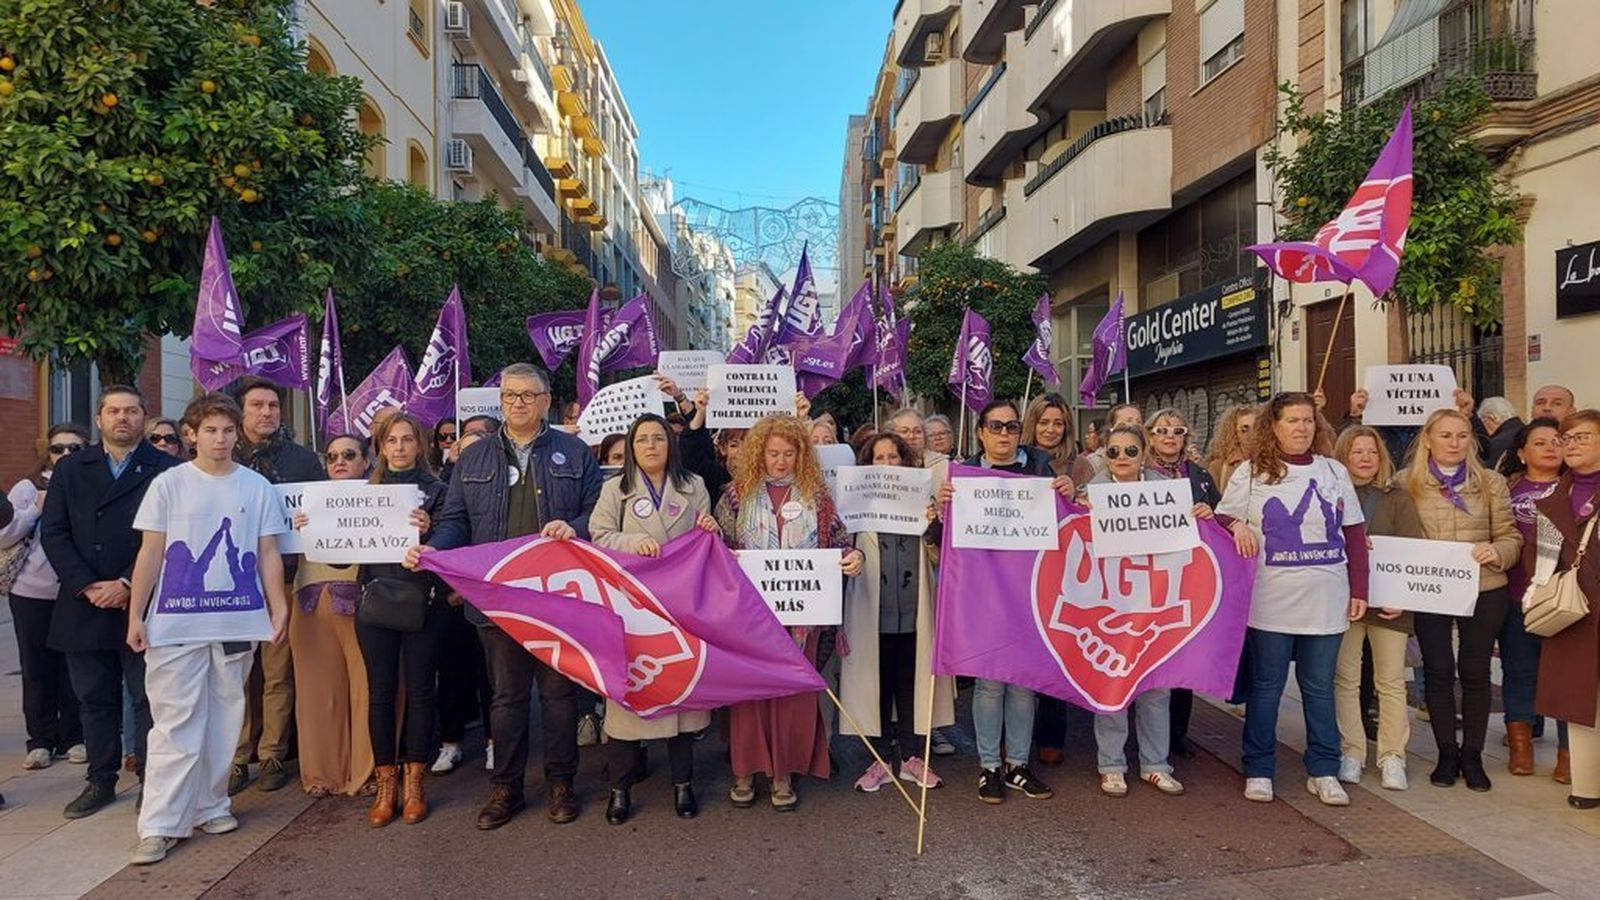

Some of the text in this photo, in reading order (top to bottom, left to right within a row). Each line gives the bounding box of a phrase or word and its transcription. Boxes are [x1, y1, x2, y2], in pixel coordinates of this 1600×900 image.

[1127, 311, 1160, 350] Gold
[1161, 300, 1218, 340] Center
[726, 373, 778, 381] CONTRA LA
[1389, 373, 1435, 383] NI UNA
[727, 385, 777, 393] VIOLENCIA
[1386, 387, 1440, 399] VÍCTIMA
[728, 398, 777, 406] MACHISTA
[712, 410, 764, 418] TOLERACIA
[1397, 403, 1424, 415] MÁS
[587, 412, 644, 426] VIOLENC
[883, 473, 901, 481] QUE
[973, 488, 1035, 500] ROMPE EL
[1107, 491, 1176, 509] NO A LA
[325, 496, 395, 508] ROMPE EL
[1098, 513, 1190, 533] VIOLENCIA
[964, 525, 1049, 537] ALZA LA VOZ
[314, 535, 409, 549] ALZA LA VOZ
[764, 559, 814, 571] NI UNA
[1376, 562, 1472, 580] NOS QUEREMOS
[1062, 530, 1197, 613] UGT
[761, 577, 821, 592] VÍCTIMA
[1408, 581, 1442, 594] VIVAS
[774, 599, 804, 612] MÁS
